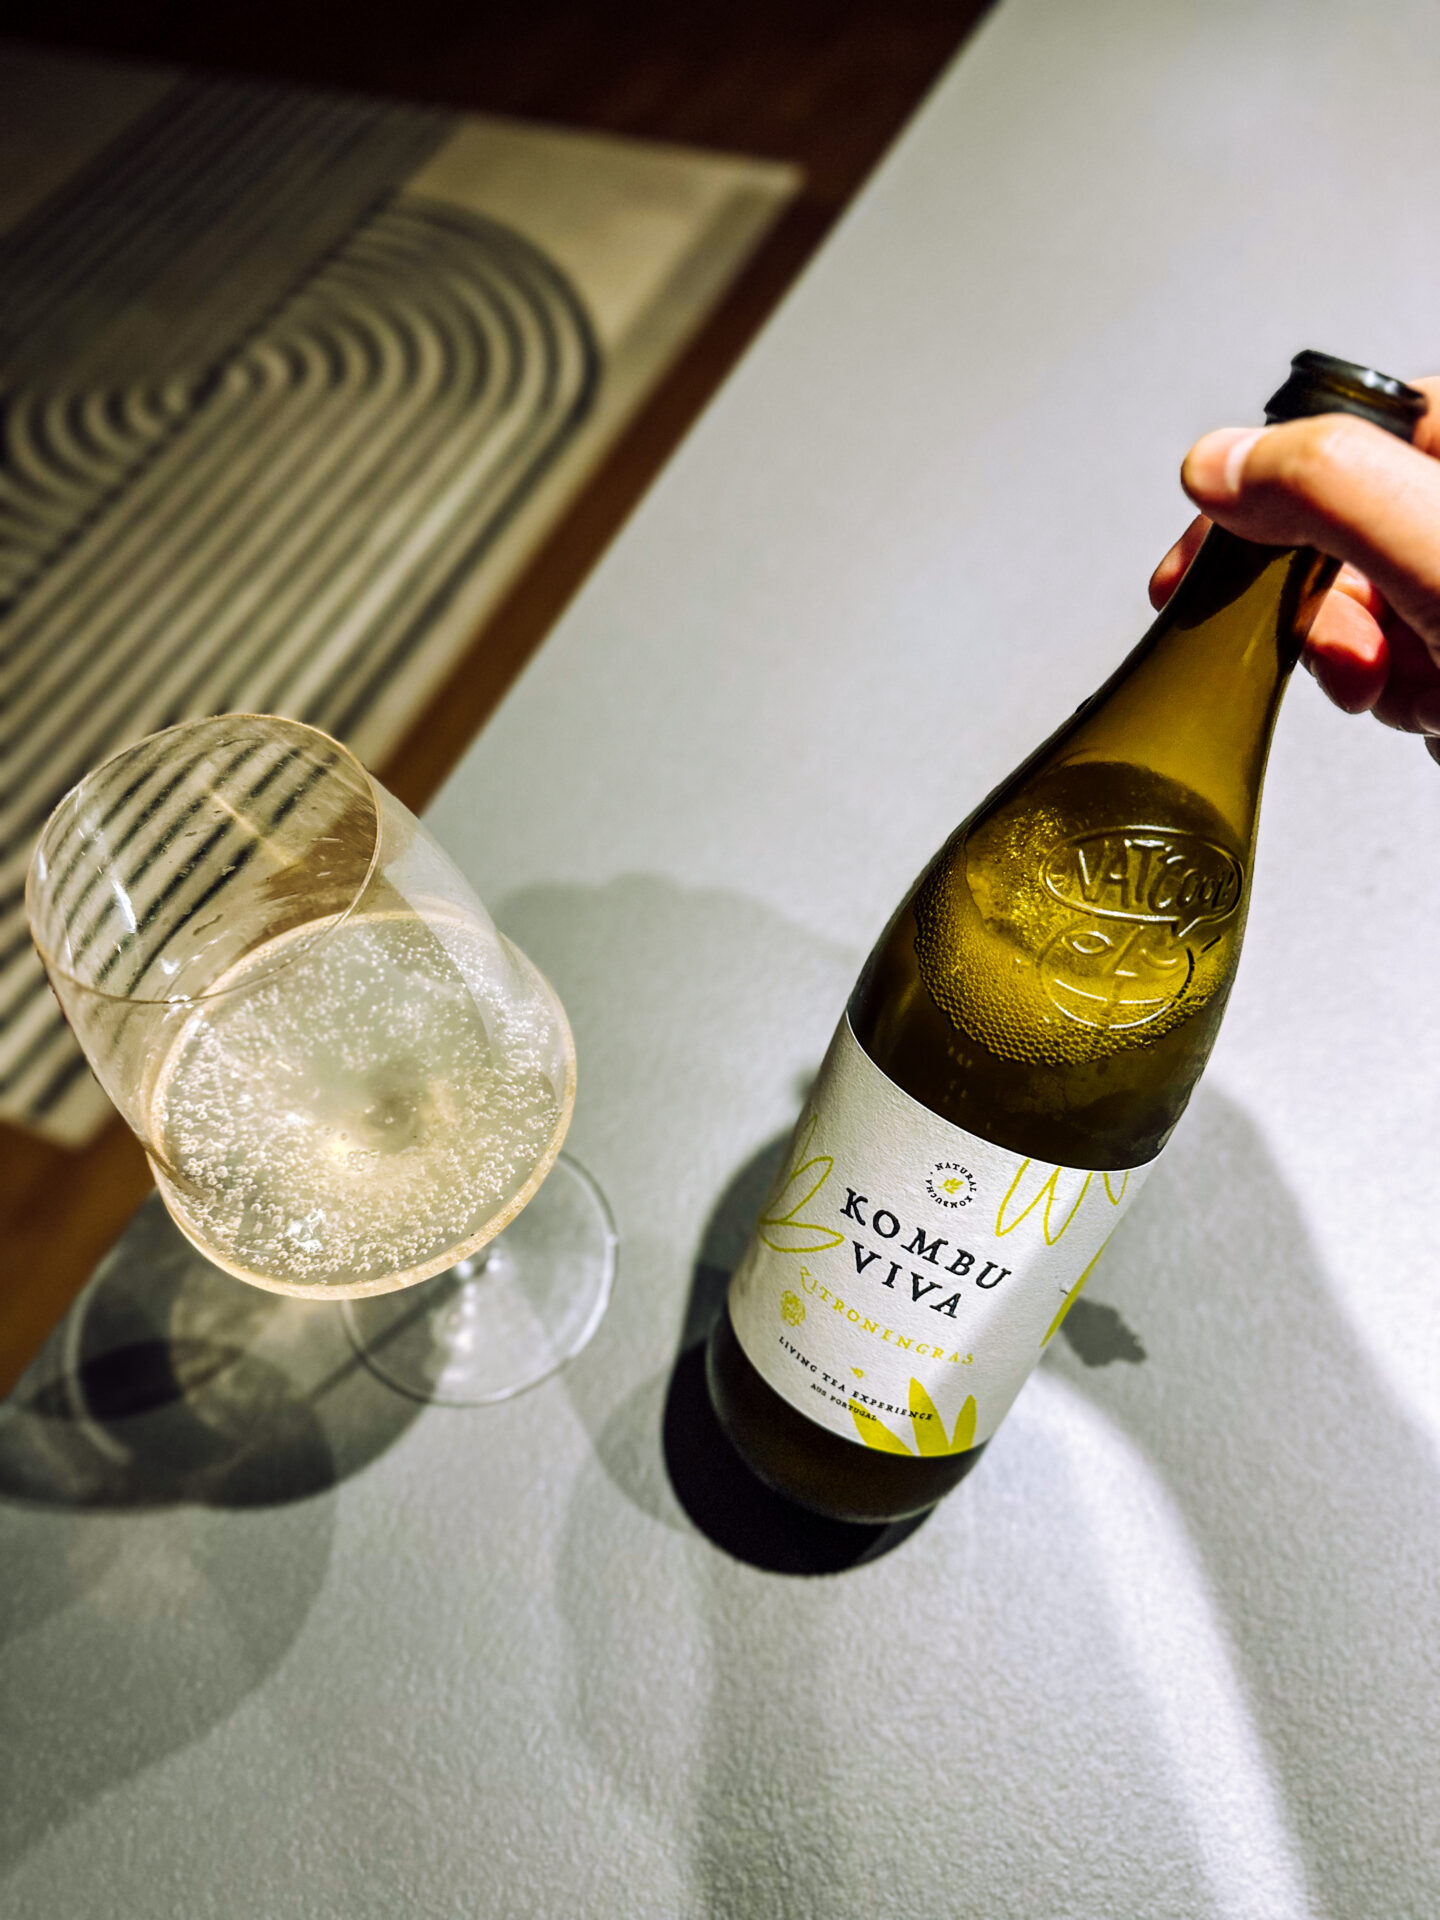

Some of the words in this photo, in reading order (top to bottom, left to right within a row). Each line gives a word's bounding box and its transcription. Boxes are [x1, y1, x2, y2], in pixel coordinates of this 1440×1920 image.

[925, 1179, 973, 1209] KOMBUCHA
[934, 1161, 977, 1192] NATURAL
[839, 1187, 1012, 1290] KOMBU
[800, 1265, 974, 1365] ZITRONENGRAS
[850, 1240, 962, 1318] VIVA
[778, 1335, 818, 1373] LIVING
[822, 1372, 846, 1392] TEA
[851, 1390, 934, 1421] EXPERIENCE
[810, 1383, 827, 1397] AUS
[830, 1395, 877, 1421] PORTUGAL
